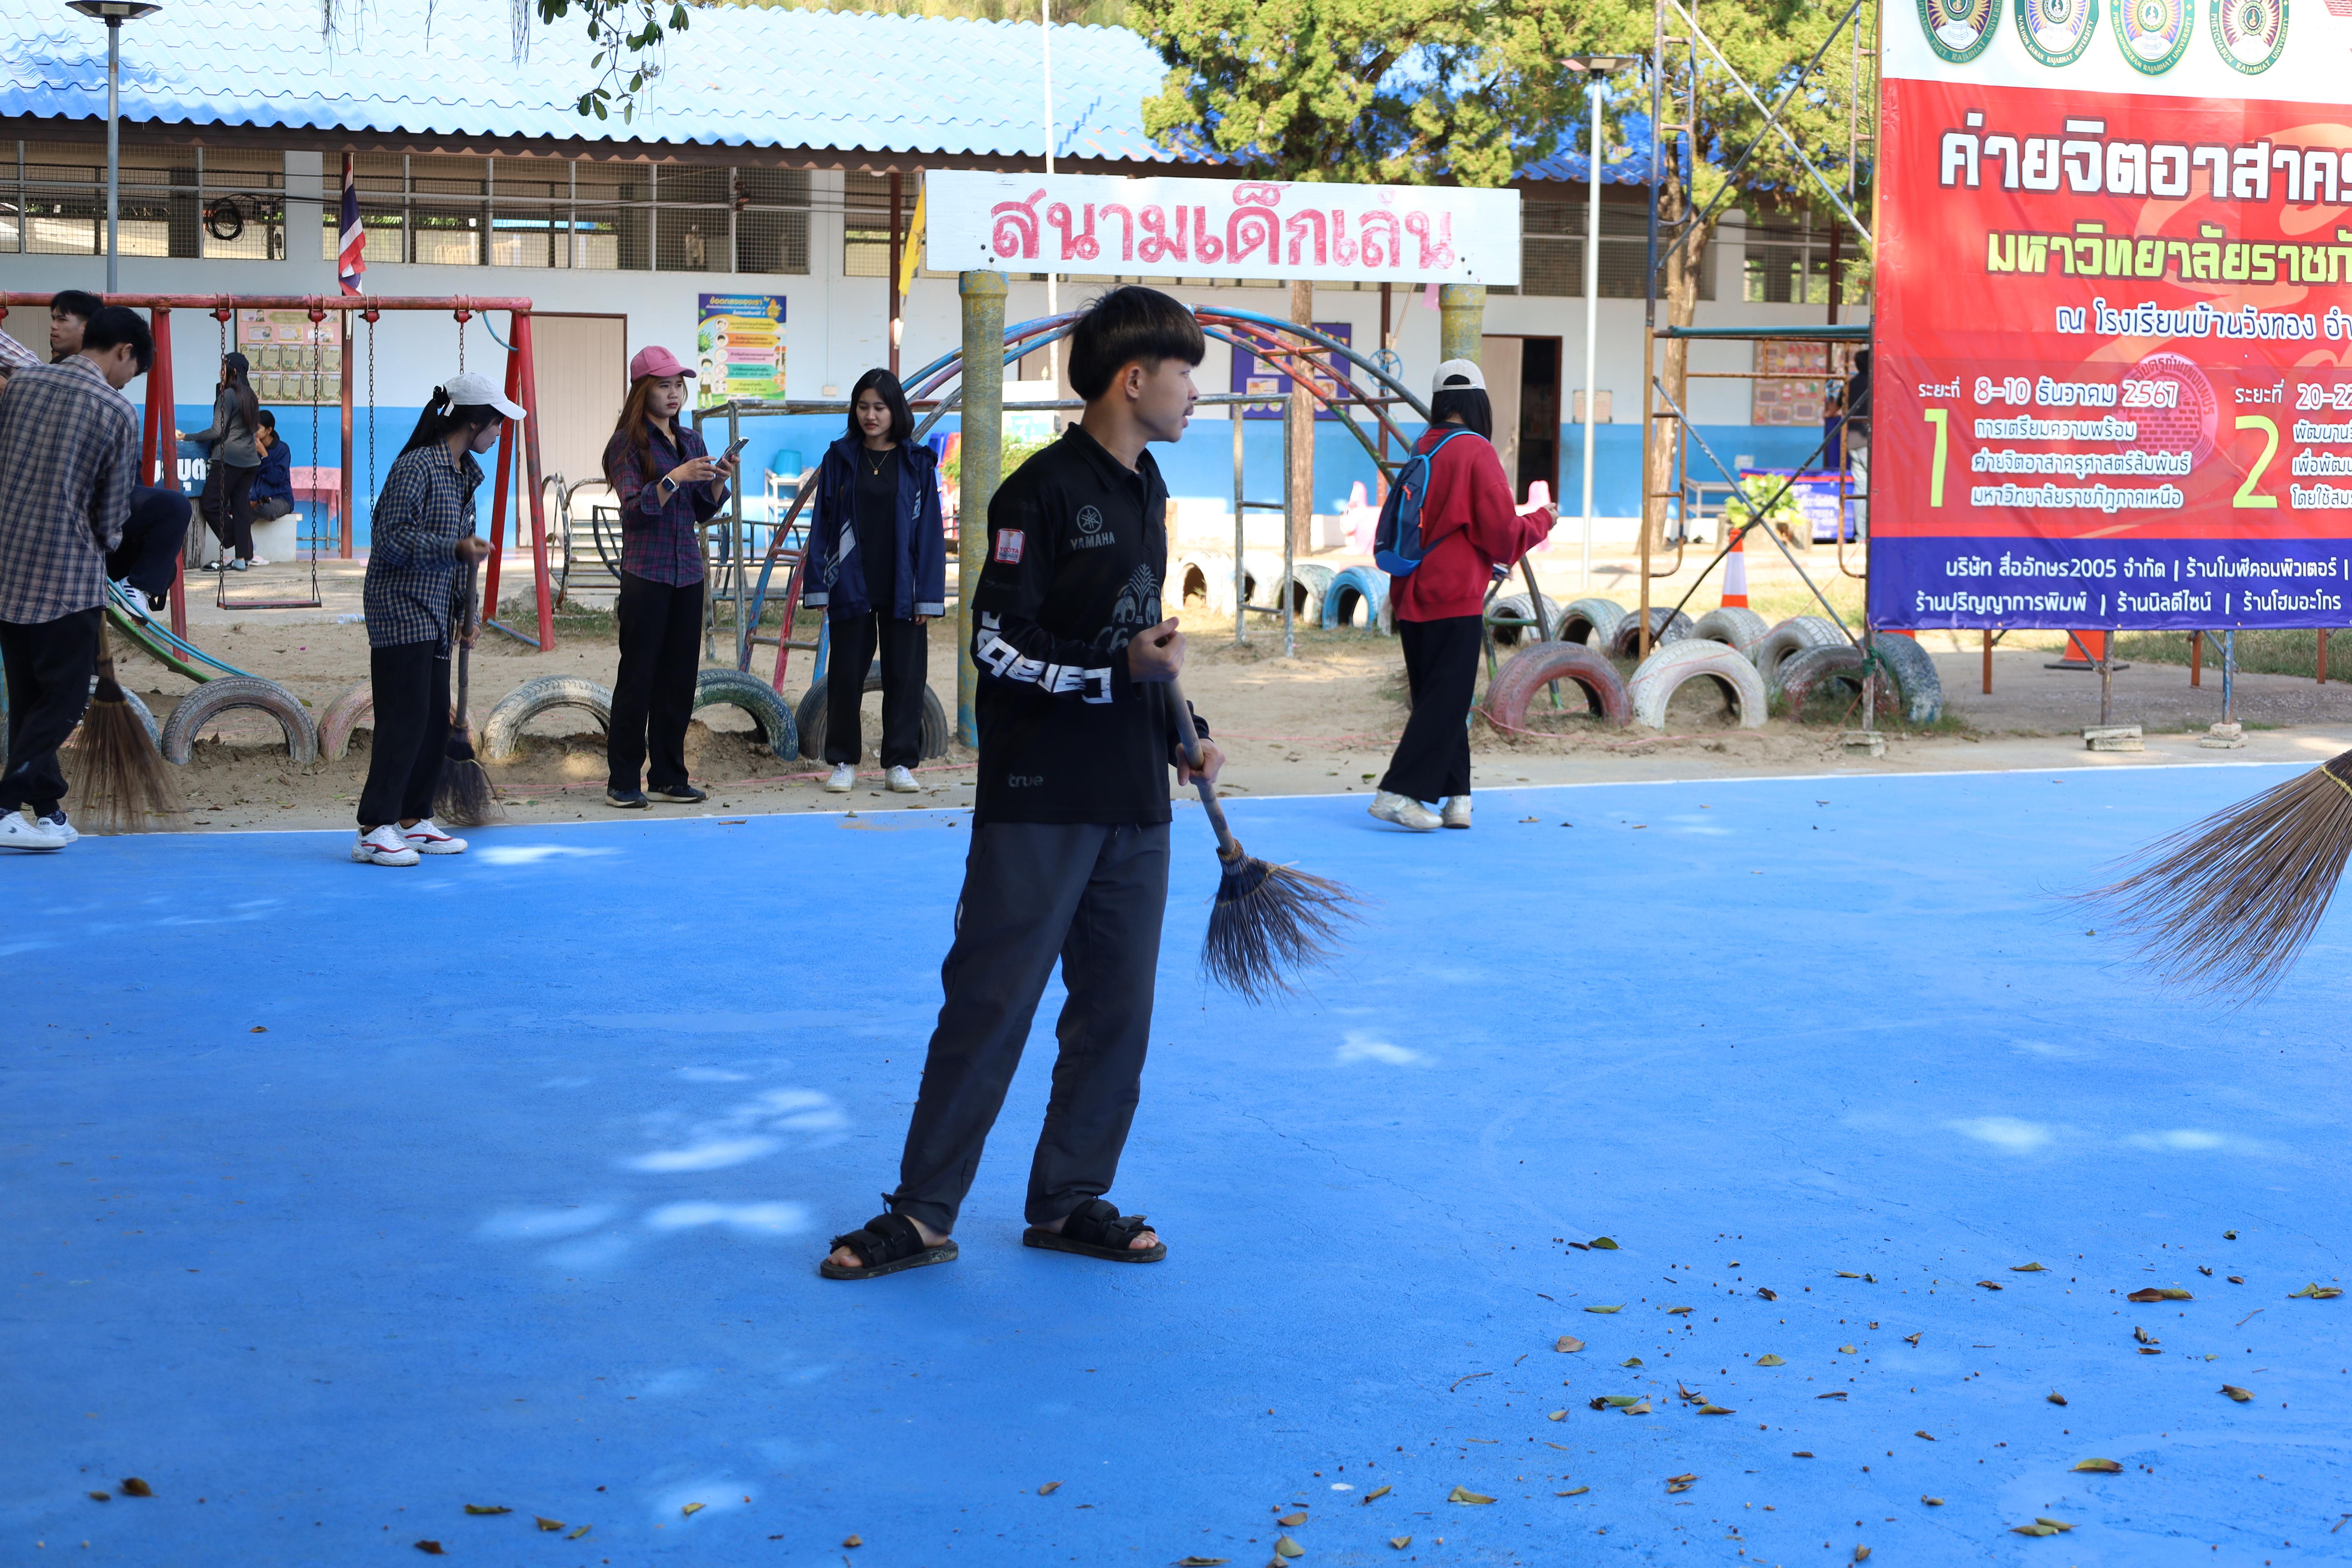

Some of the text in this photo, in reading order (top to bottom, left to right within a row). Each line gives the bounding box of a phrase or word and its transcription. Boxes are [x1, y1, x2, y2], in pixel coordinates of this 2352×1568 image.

[1918, 0, 1932, 37] PHAENG
[1931, 38, 1948, 57] PHET
[1951, 40, 1986, 62] RAJABHAT
[2027, 44, 2045, 60] SAWAN
[2046, 53, 2073, 66] RAJABHAT
[2074, 20, 2094, 56] UNIVERSITY
[2113, 12, 2192, 74] PIBULSONGKRAM RAJABHAT UNIVERSITY
[2211, 13, 2288, 74] PHETCHABUN RAJABHAT UNIVERSITY
[991, 182, 1455, 269] สนามเด็กเล่น
[2058, 308, 2084, 332] ณ
[2095, 299, 2315, 338] โรงเรียนบ้านวังทอง
[1918, 376, 1960, 398] ระยะที่
[1976, 377, 2177, 406] 8-10 ธันวาคม 2567
[2234, 378, 2285, 404] ระยะที่
[1976, 416, 2136, 439] การเตรียมความพร้อม
[1923, 408, 1948, 507] 1
[1973, 449, 2191, 478] ค่ายจิตอาสาครุศาสตร์สัมพันธ์
[2233, 415, 2279, 508] 2
[1972, 485, 2182, 511] มหาวิทยาลัยราชภัฏภาคเหนือ
[2291, 485, 2352, 507] โดยใช้สม
[1070, 531, 1115, 550] YAMAHA
[1946, 555, 1992, 577] บริษัท
[1998, 551, 2117, 578] สื่ออักษร2005
[2123, 557, 2166, 578] จำกัด
[1916, 588, 2342, 615] ร้านปริญญาการพิมพ์ ร้านนิลดีไซน์ ร้านโฮมอะโกร
[1008, 773, 1044, 787] true
